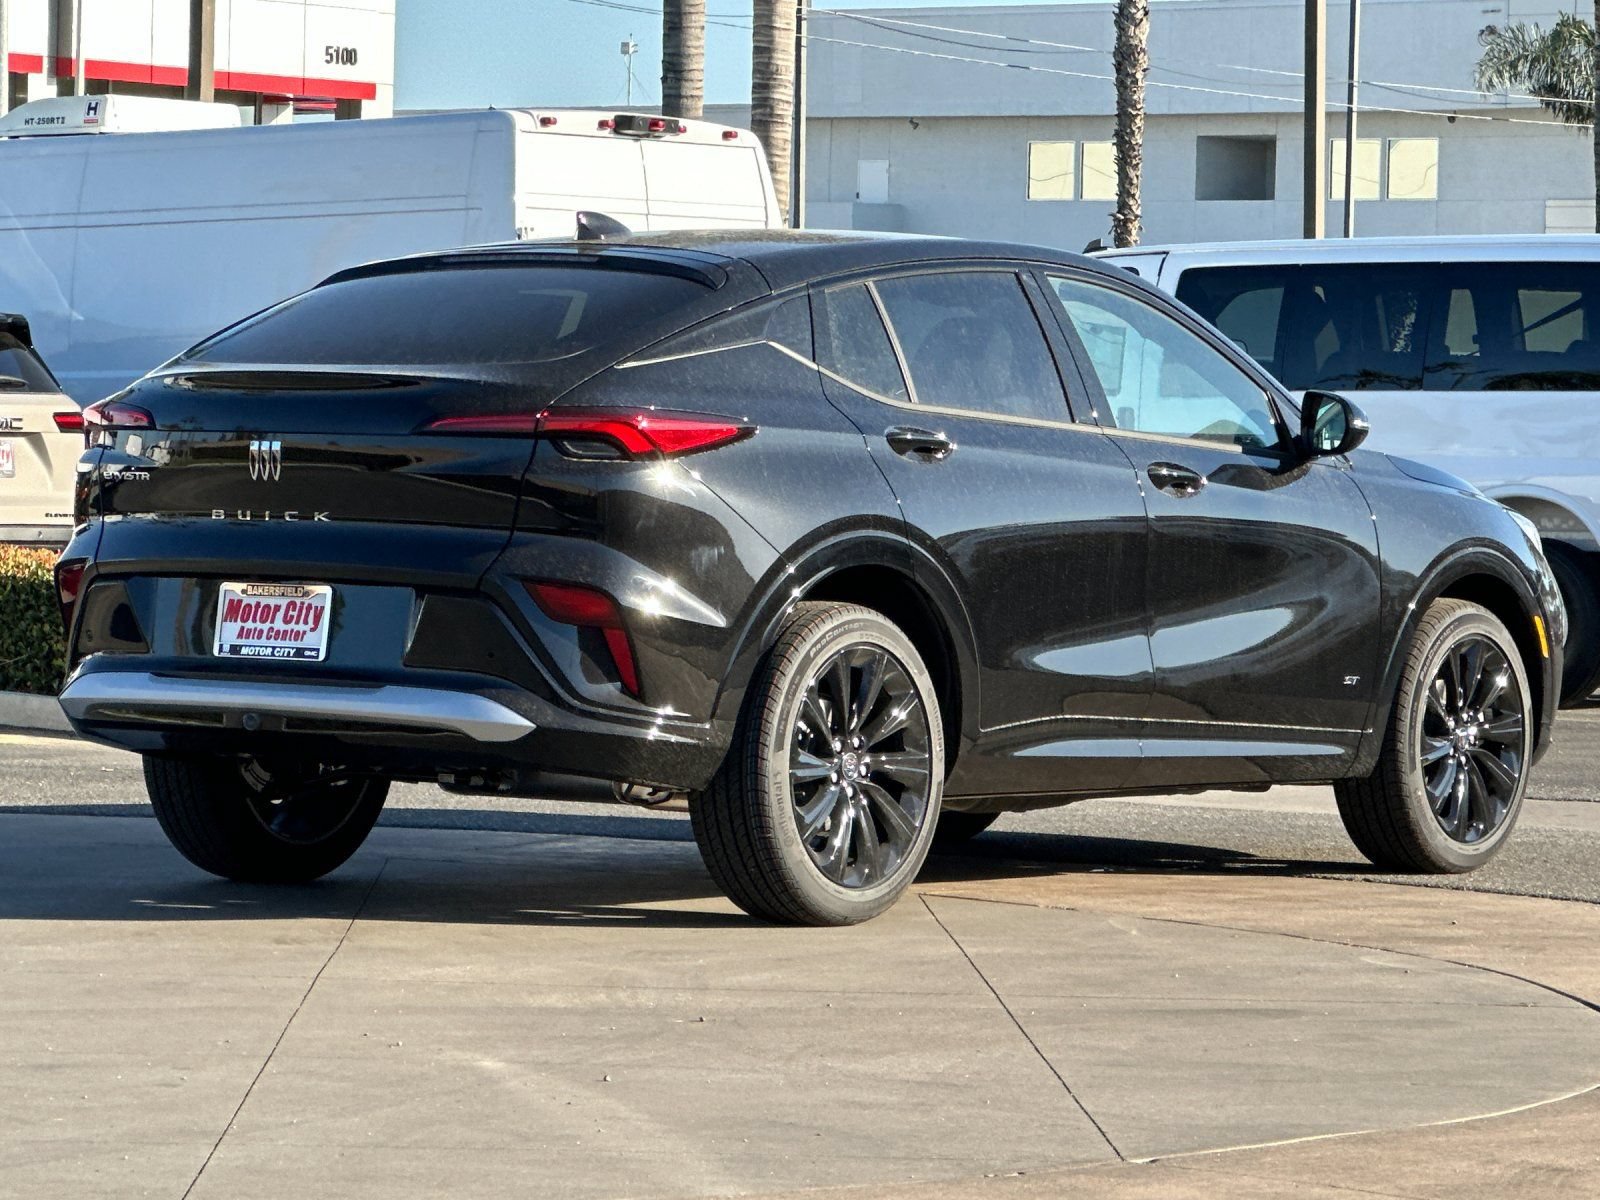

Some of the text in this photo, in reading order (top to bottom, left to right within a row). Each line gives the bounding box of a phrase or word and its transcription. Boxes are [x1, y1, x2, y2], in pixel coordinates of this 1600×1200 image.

[324, 45, 358, 66] 5100
[86, 101, 99, 116] H
[0, 417, 23, 430] MC
[211, 508, 332, 522] BUICK
[246, 585, 304, 597] BAKERSFIELD
[223, 598, 325, 632] Motor City
[236, 625, 307, 642] Auto Center
[240, 646, 274, 656] MOTOR
[274, 648, 297, 657] CITY
